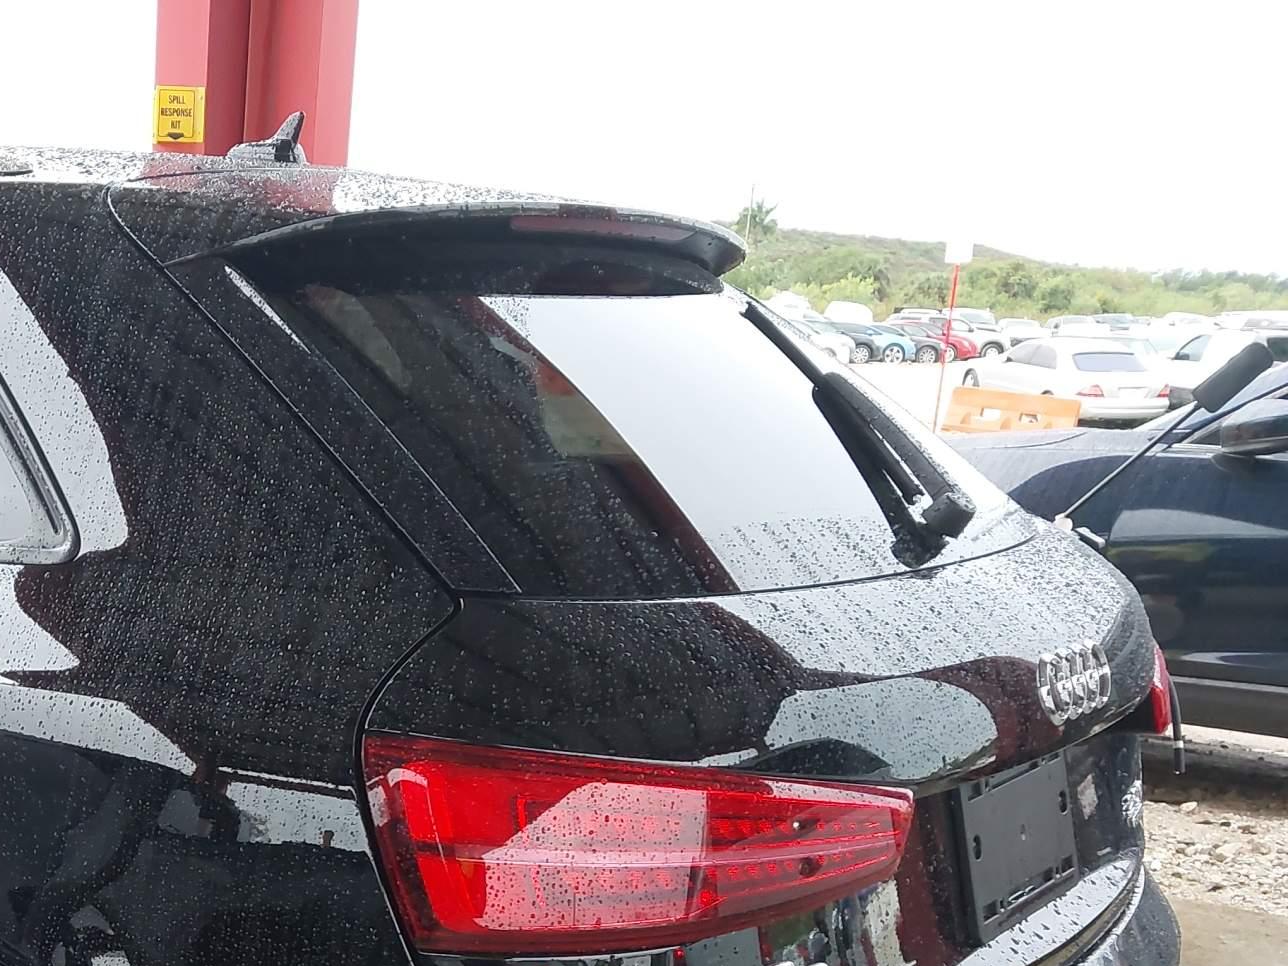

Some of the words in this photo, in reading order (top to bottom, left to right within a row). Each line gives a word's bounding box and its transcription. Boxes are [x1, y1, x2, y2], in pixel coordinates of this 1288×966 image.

[168, 95, 185, 105] SPILL
[160, 107, 193, 118] RESPONSE
[170, 120, 181, 130] KIT
